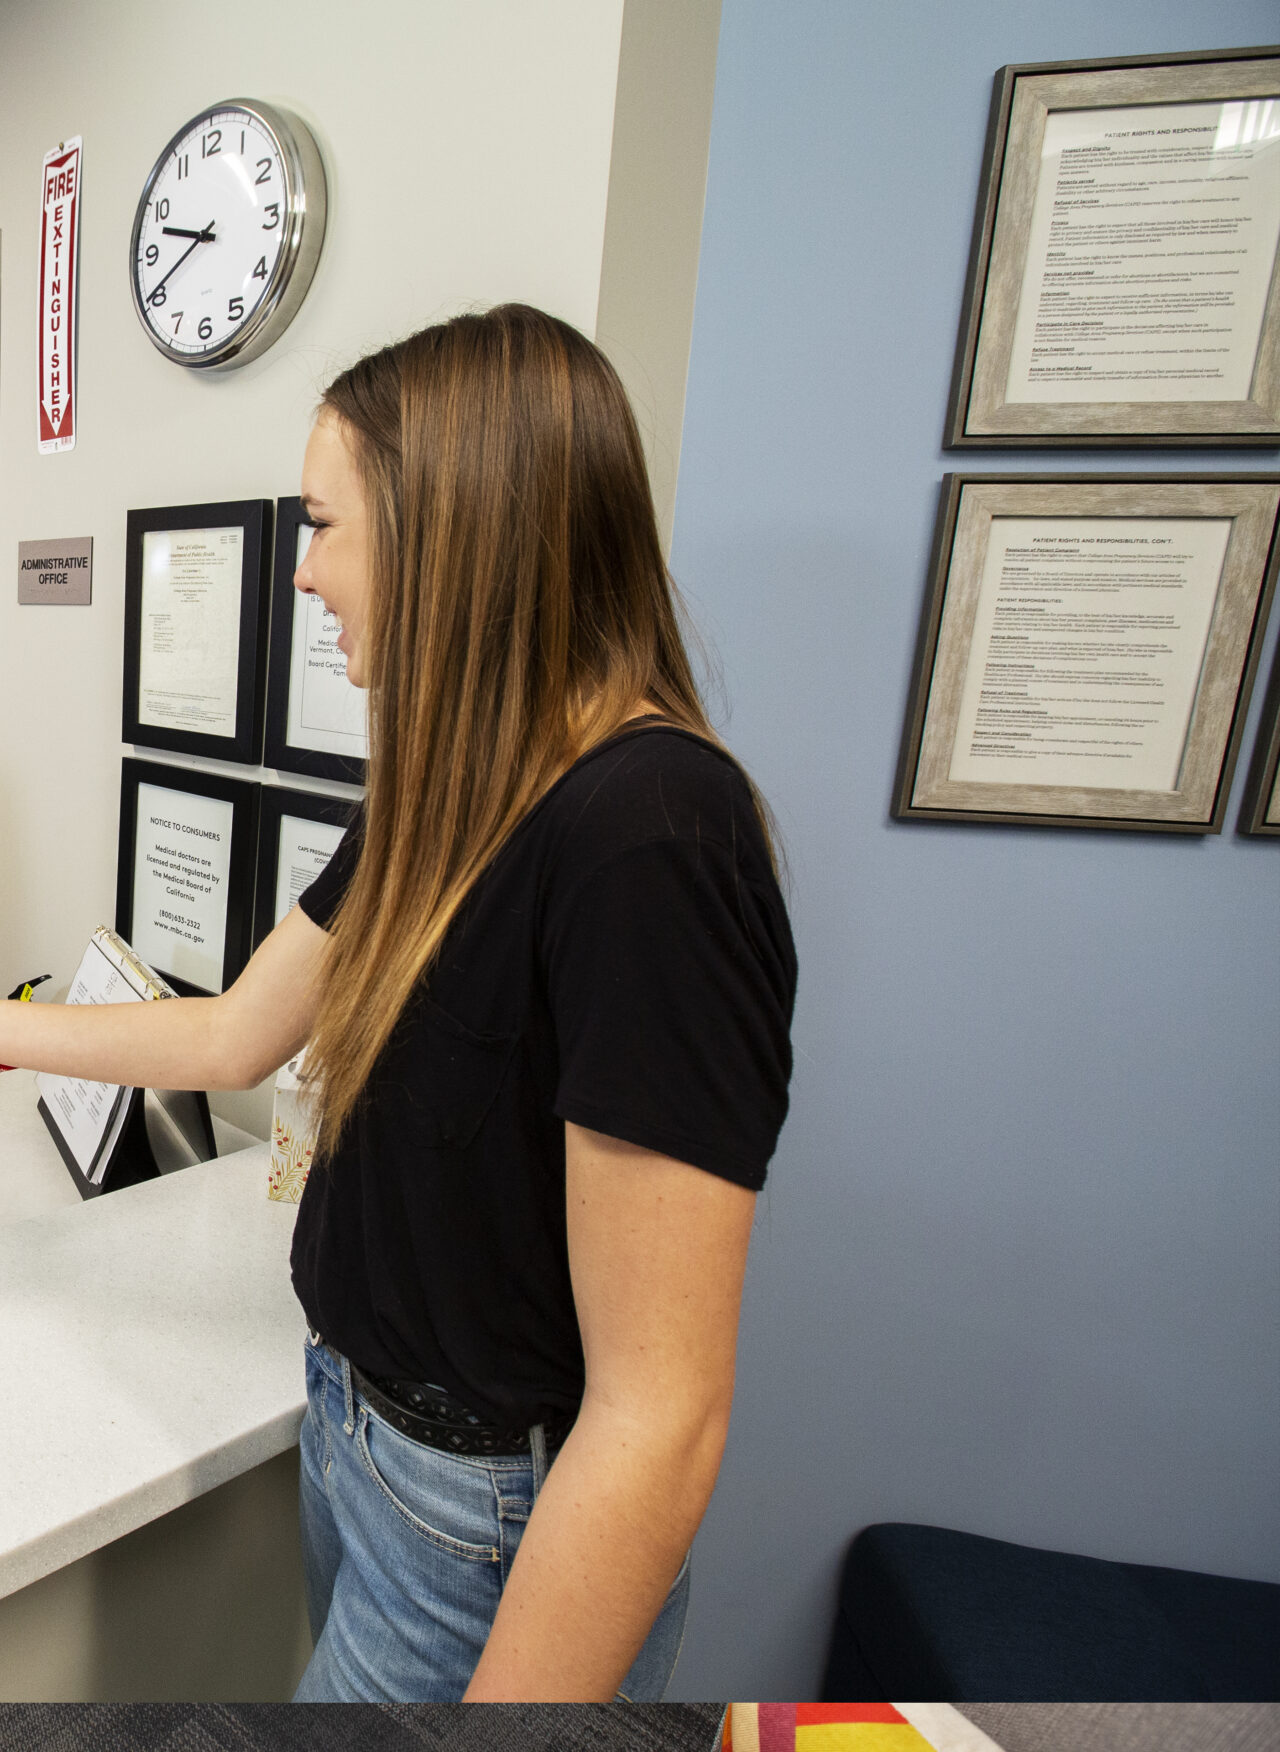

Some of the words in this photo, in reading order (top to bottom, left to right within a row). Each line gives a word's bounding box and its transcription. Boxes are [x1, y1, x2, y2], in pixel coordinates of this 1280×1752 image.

[202, 130, 222, 158] 12
[241, 130, 245, 155] 1
[1132, 129, 1155, 137] RIGHTS
[178, 154, 189, 180] 11
[255, 158, 272, 185] 2
[47, 167, 74, 204] FIRE
[155, 198, 170, 222] 10
[262, 203, 279, 230] 3
[145, 244, 159, 266] 9
[253, 256, 268, 280] 4
[152, 285, 167, 307] 8
[51, 205, 63, 423] EXTINGUISHER
[227, 297, 244, 321] 5
[171, 311, 184, 334] 7
[198, 317, 212, 340] 6
[21, 557, 88, 570] ADMINISTRATIVE
[39, 573, 68, 584] OFFICE
[308, 660, 324, 668] Board
[150, 817, 171, 829] NOTICE
[172, 823, 181, 831] TO
[182, 825, 220, 842] CONSUMERS
[155, 844, 176, 857] Medical
[178, 849, 200, 863] doctors
[201, 858, 211, 866] are
[147, 854, 168, 867] licensed
[170, 862, 180, 871] and
[182, 865, 210, 880] regulated
[211, 874, 220, 884] by
[153, 869, 162, 878] the
[163, 873, 185, 885] Medical
[186, 879, 203, 891] Board
[205, 886, 211, 894] of
[166, 886, 195, 902] California
[154, 920, 204, 944] www.mbc.ca.gov
